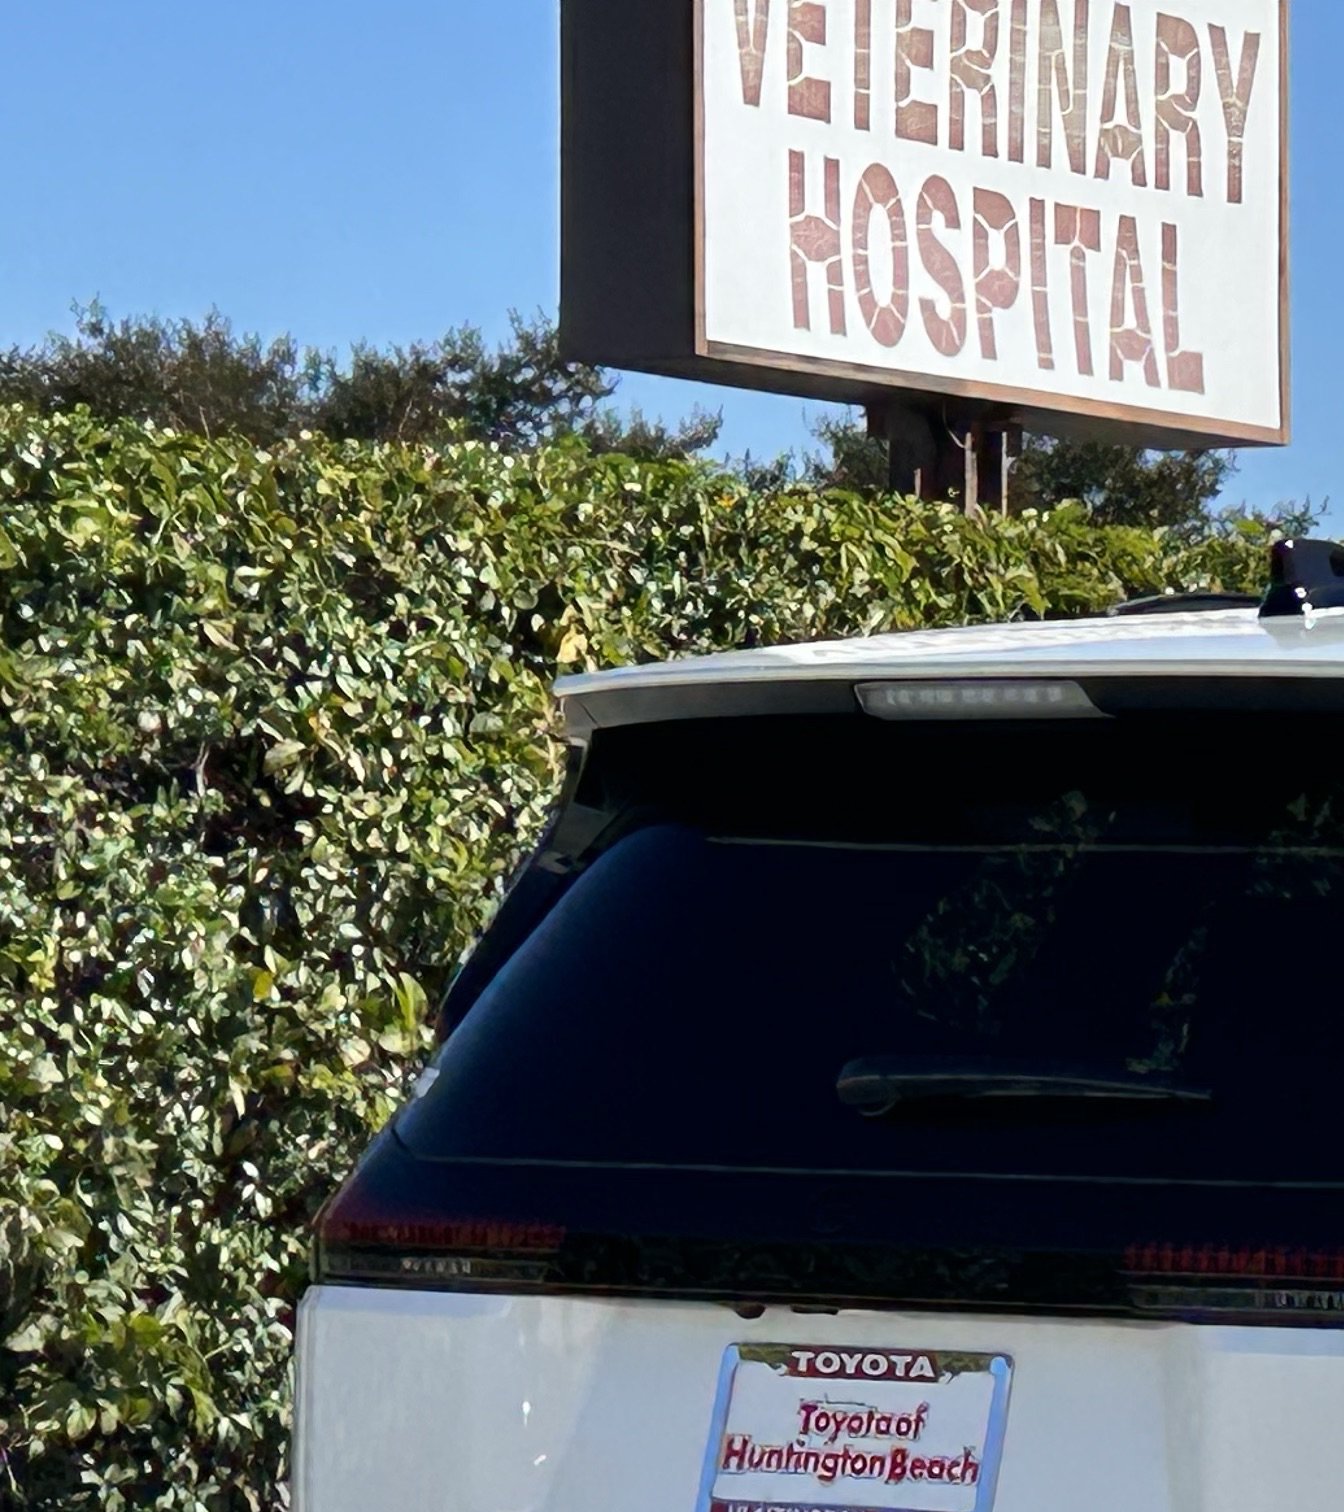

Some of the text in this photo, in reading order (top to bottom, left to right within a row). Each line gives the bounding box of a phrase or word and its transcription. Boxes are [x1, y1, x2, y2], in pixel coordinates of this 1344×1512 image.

[734, 0, 1260, 204] VETERINARY
[788, 149, 1205, 394] HOSPITAL
[791, 1350, 935, 1378] TOYOTA
[799, 1401, 929, 1445] Toyota of
[721, 1434, 980, 1484] Huntington Beach
